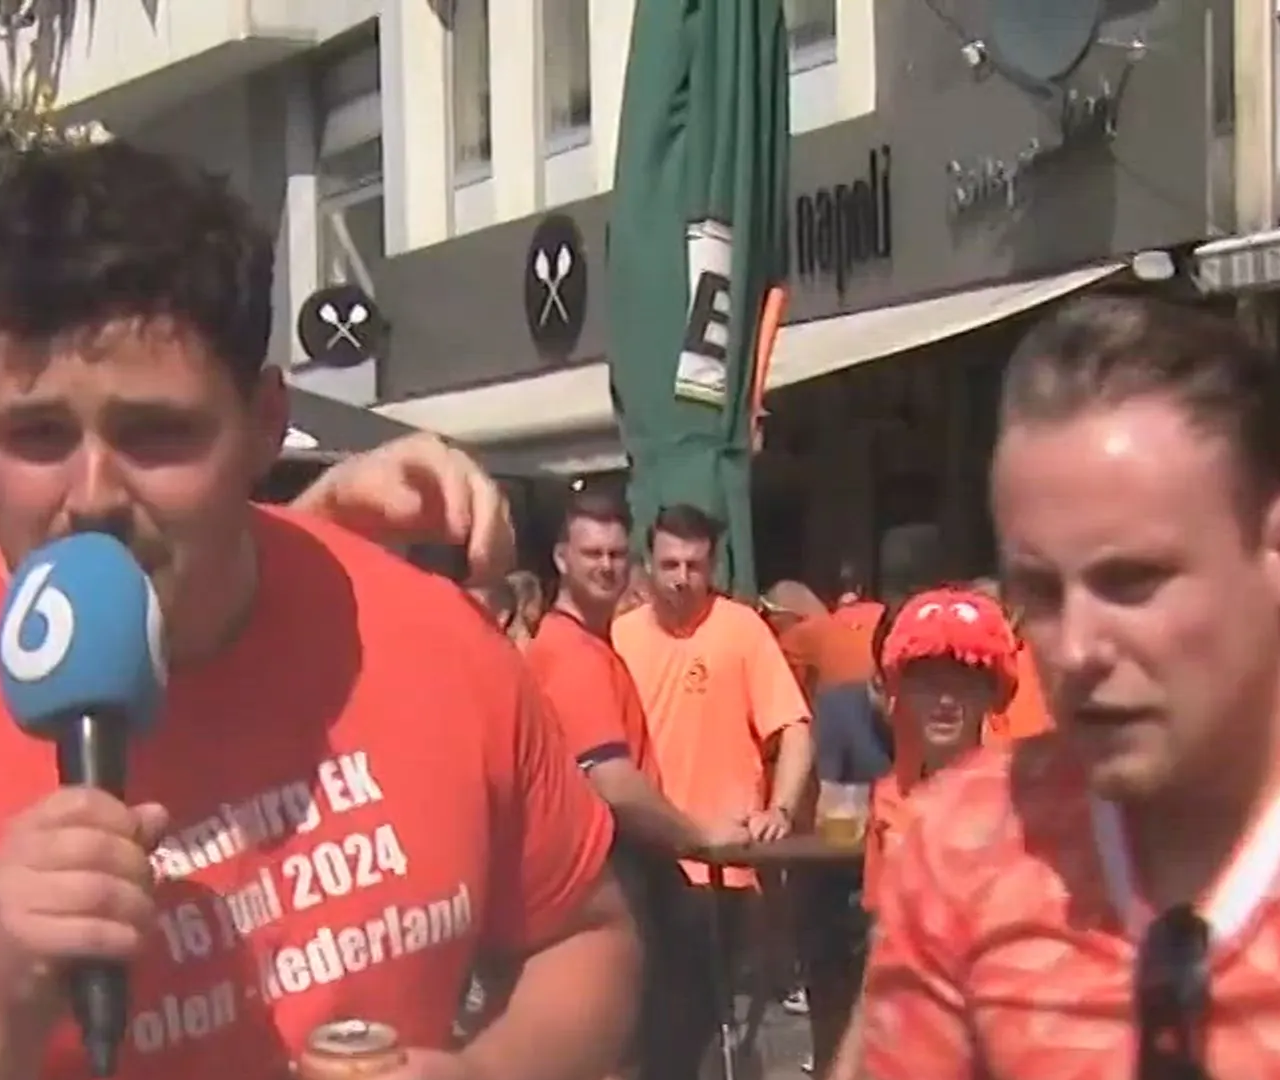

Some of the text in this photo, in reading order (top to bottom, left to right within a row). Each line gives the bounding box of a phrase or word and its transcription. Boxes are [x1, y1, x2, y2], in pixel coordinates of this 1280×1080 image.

[795, 143, 892, 303] napoli
[0, 559, 75, 682] 6
[150, 750, 384, 884] amburg EK
[158, 902, 213, 964] 16
[282, 823, 408, 912] 2024
[131, 979, 236, 1054] olen
